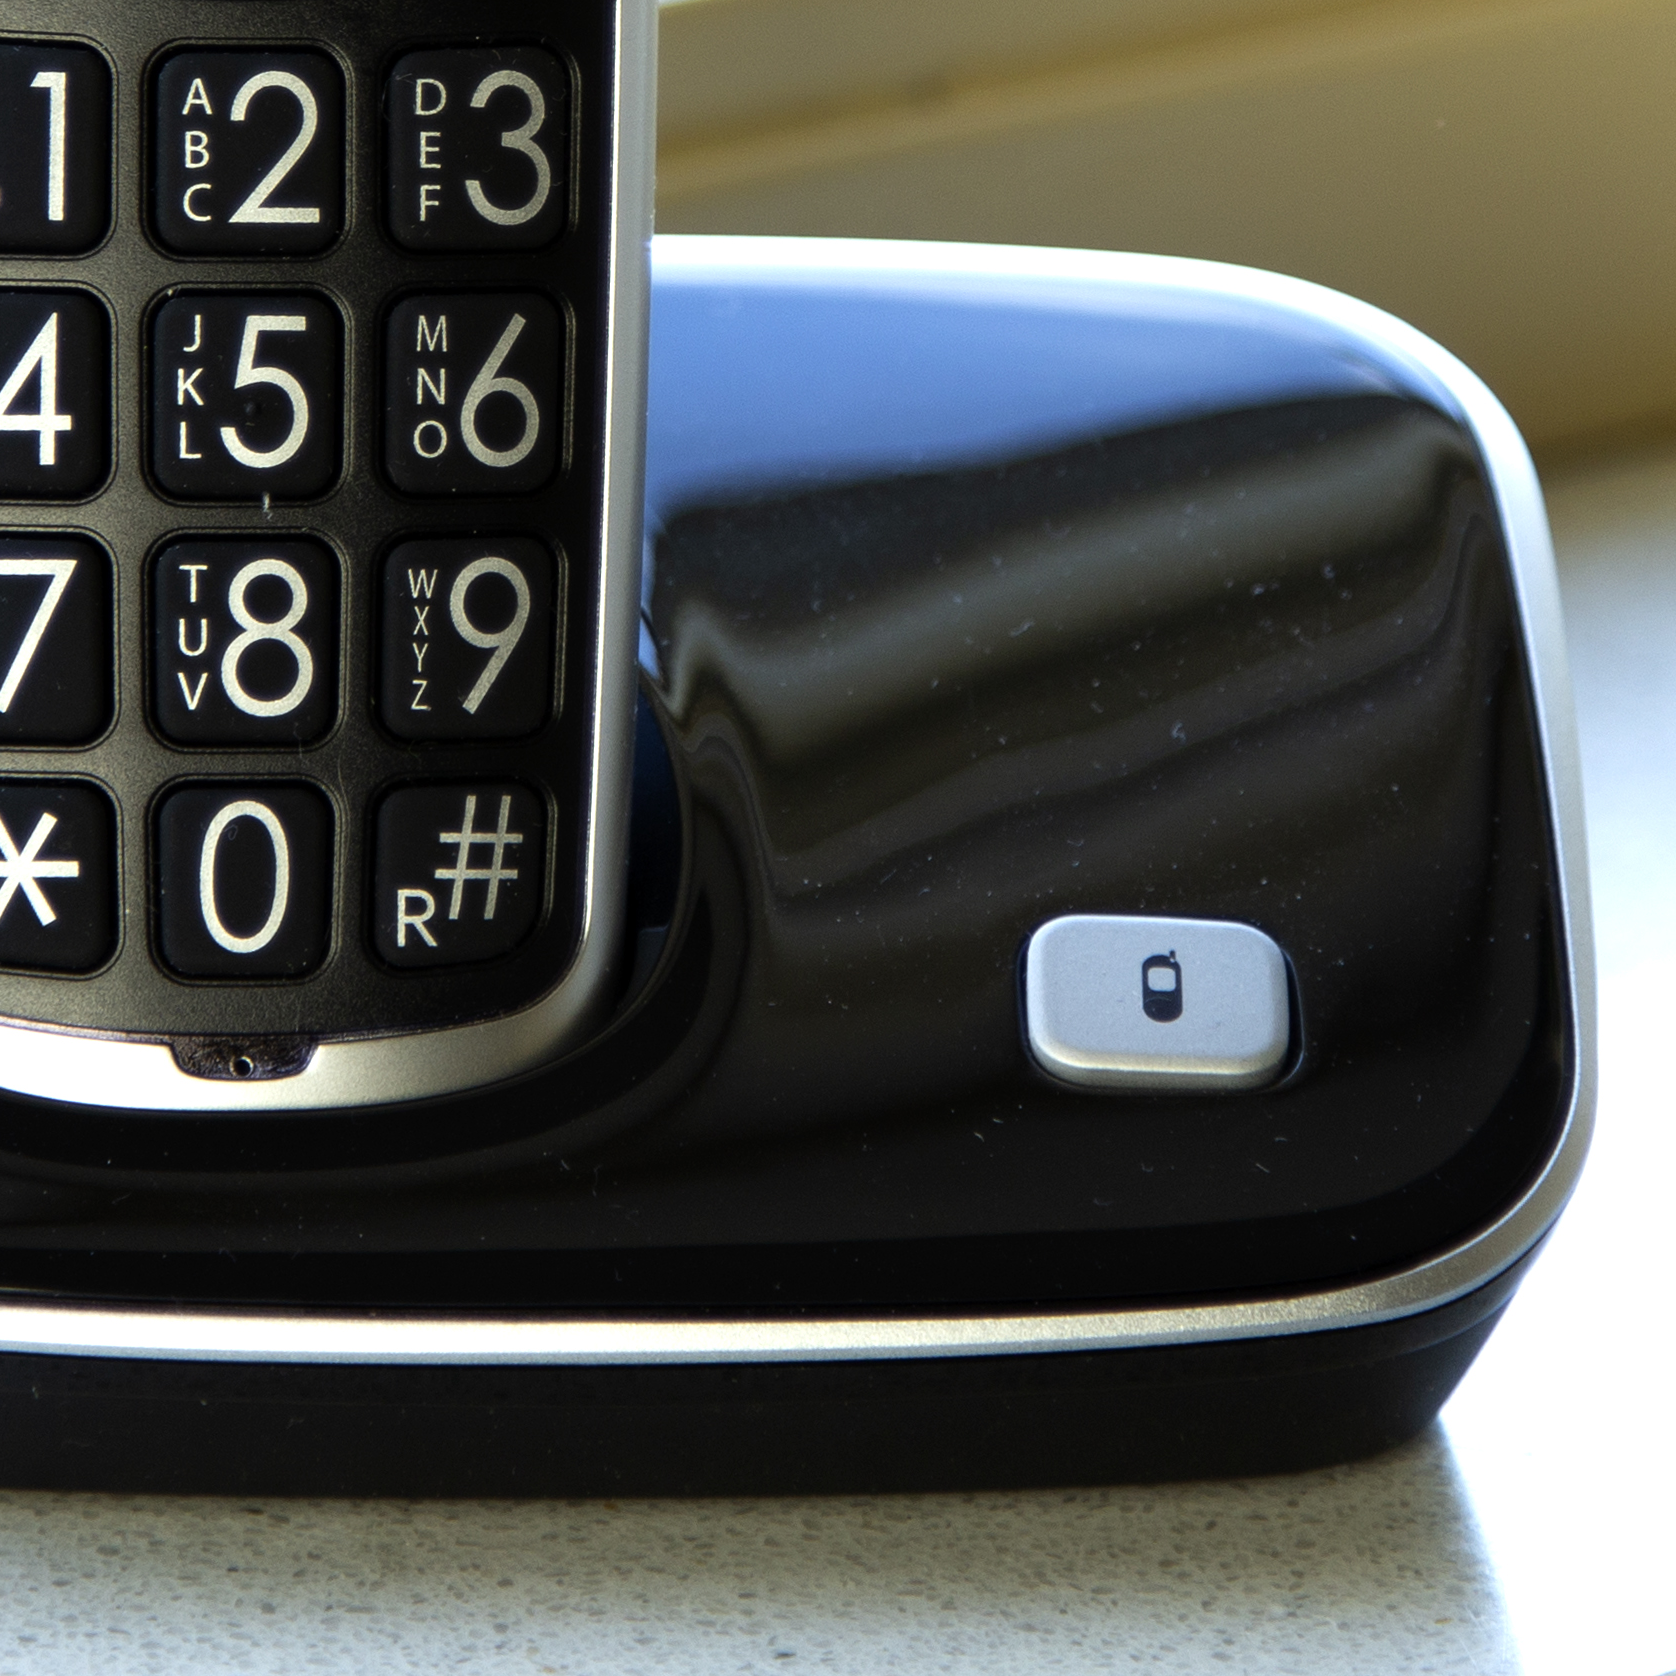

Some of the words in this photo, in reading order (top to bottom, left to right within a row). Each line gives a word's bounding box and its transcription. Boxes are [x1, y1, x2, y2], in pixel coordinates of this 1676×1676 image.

[30, 72, 67, 221] 1
[228, 70, 320, 224] 2
[464, 69, 551, 226] 3
[220, 315, 309, 469] 5
[460, 313, 540, 468] 6
[220, 558, 314, 717] 8
[449, 556, 531, 715] 9
[199, 800, 290, 954] 0
[397, 889, 438, 947] R
[434, 795, 524, 920] #
